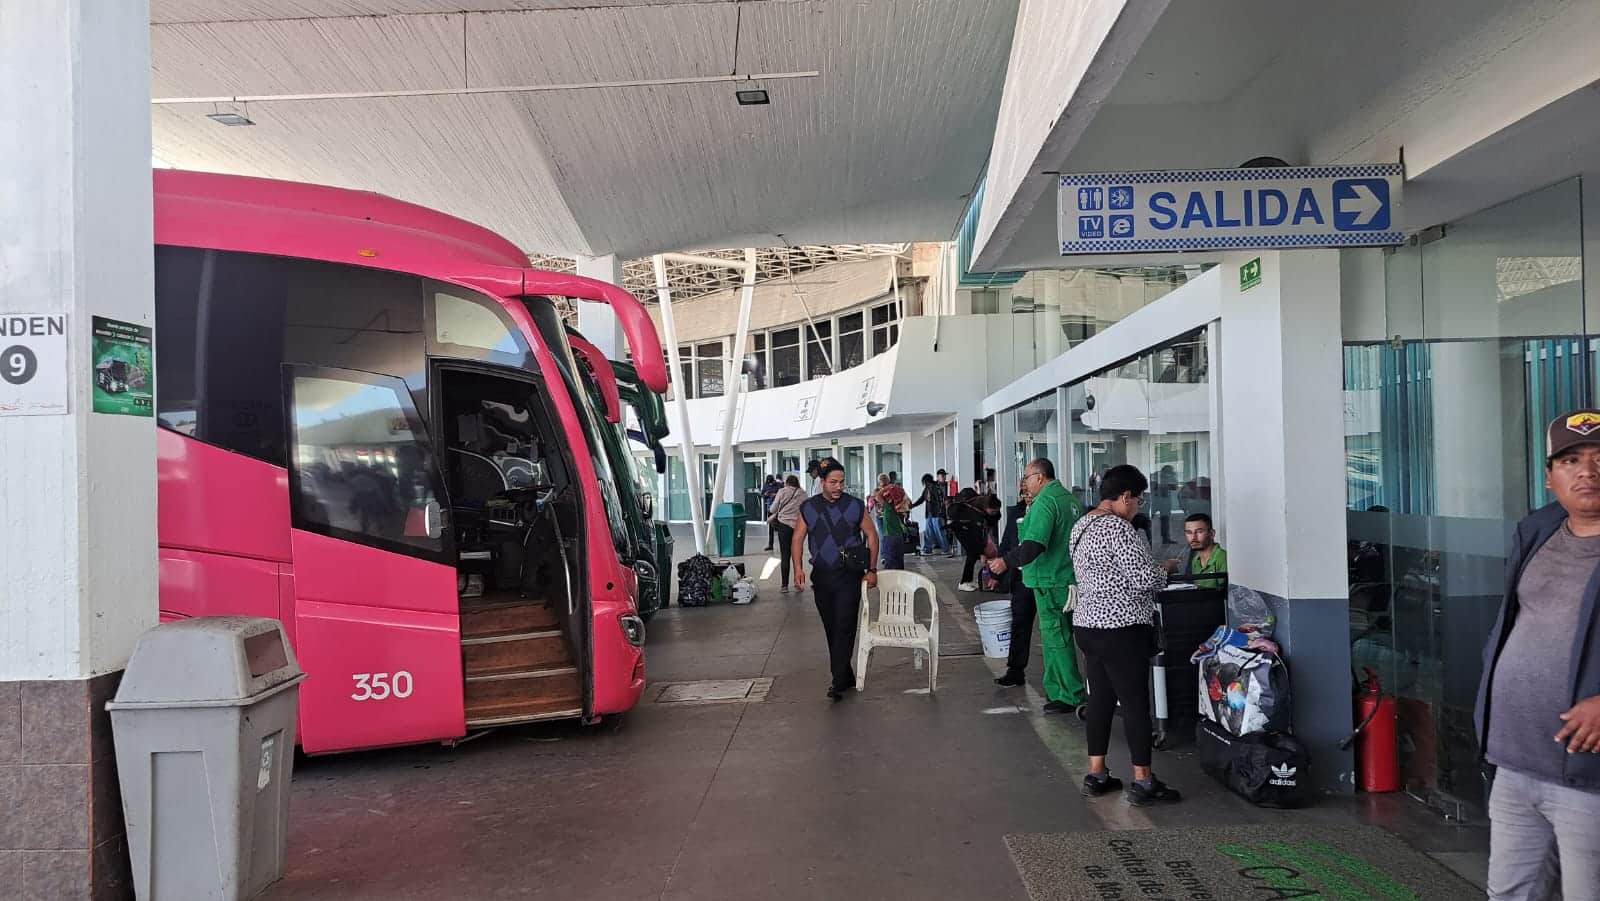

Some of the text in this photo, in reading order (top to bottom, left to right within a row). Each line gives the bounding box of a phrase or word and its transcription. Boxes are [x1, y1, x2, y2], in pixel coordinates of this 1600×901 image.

[1148, 187, 1325, 231] SALIDA
[1080, 217, 1101, 231] TV
[9, 353, 26, 377] 9
[351, 670, 413, 701] 350
[1269, 778, 1297, 786] adidas
